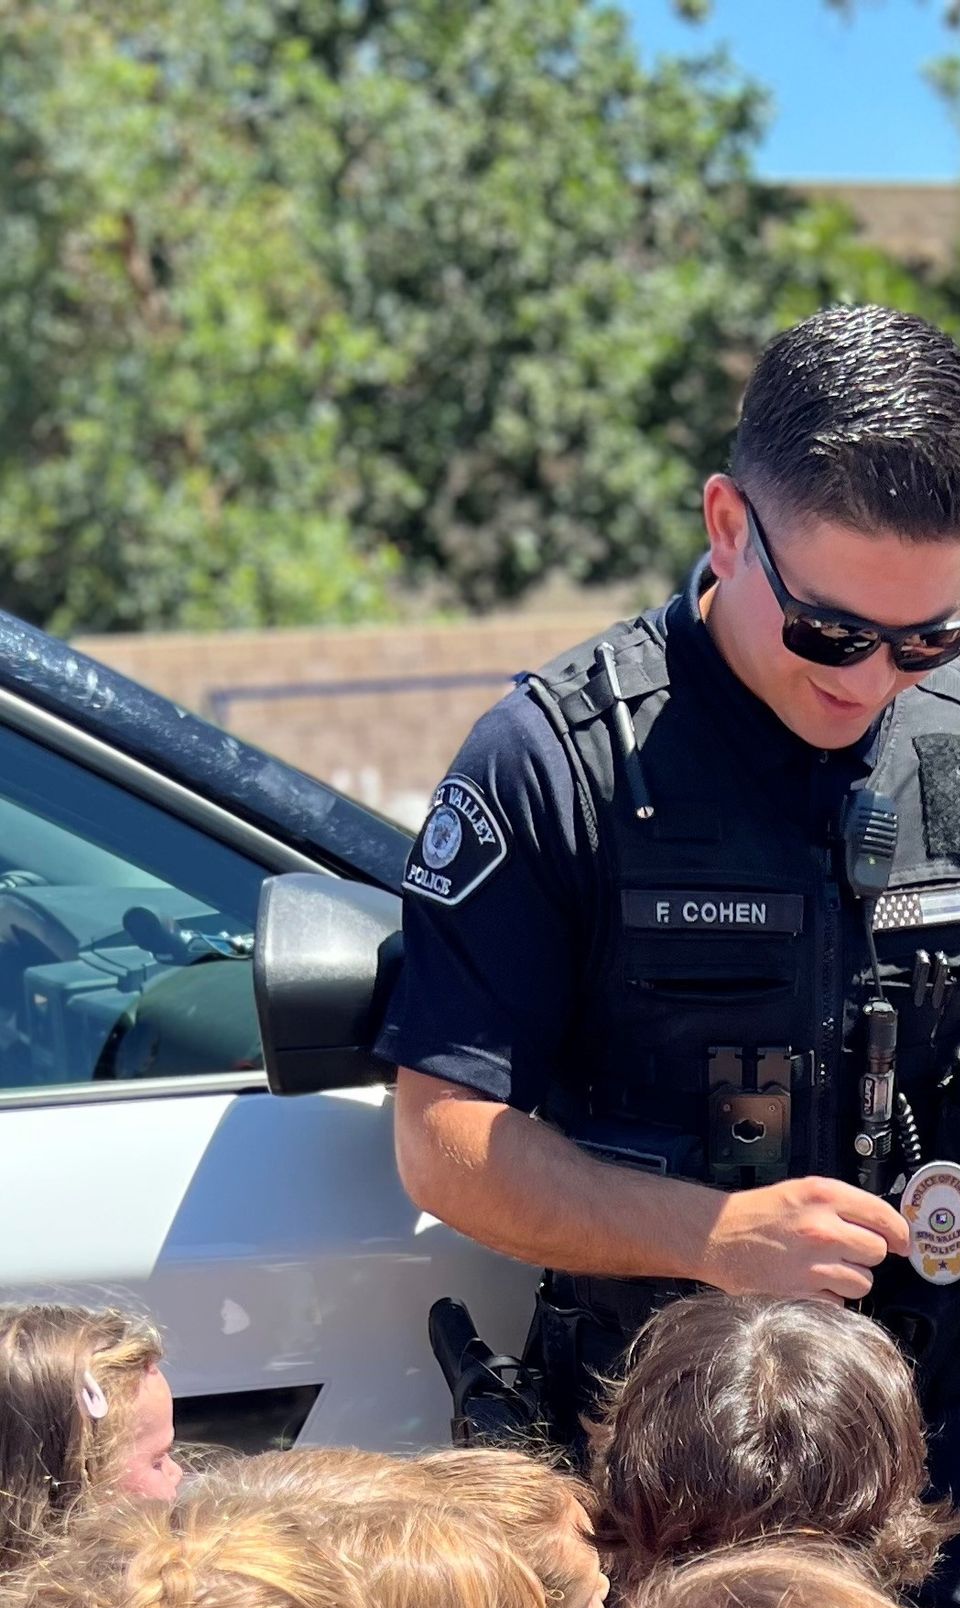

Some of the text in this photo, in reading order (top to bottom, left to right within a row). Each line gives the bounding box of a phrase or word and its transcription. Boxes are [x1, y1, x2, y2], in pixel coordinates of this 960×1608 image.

[449, 787, 496, 845] VALLEY
[408, 864, 452, 895] POLICE
[682, 902, 766, 924] COHEN
[911, 1175, 938, 1207] POLICE
